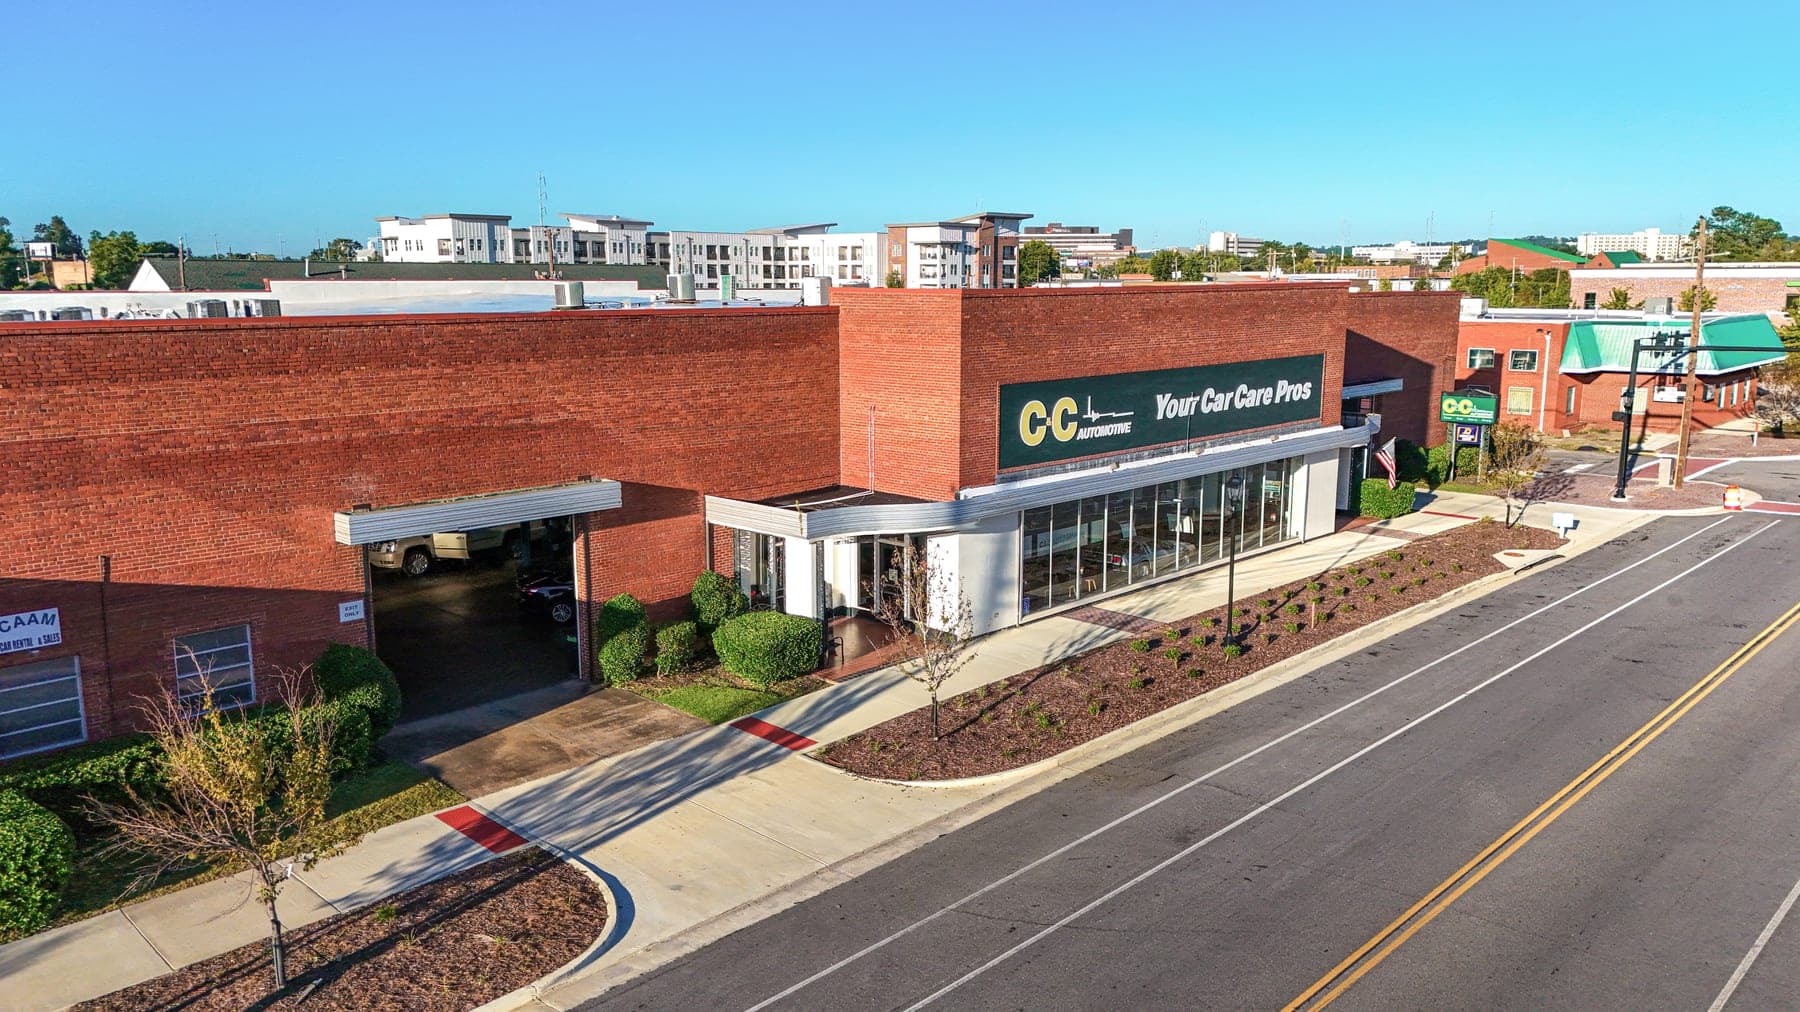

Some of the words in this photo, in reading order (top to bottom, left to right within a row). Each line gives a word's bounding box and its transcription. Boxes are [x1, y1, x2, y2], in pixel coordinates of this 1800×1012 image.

[1156, 392, 1200, 420] Your
[1201, 387, 1234, 414] Car
[1234, 384, 1273, 409] Care
[1275, 380, 1312, 404] Pros
[1076, 421, 1132, 440] AUTOMOTIVE
[0, 613, 56, 633] CAAM
[0, 641, 12, 652] CAR
[12, 637, 34, 649] RENTAL
[43, 633, 60, 644] SALES
